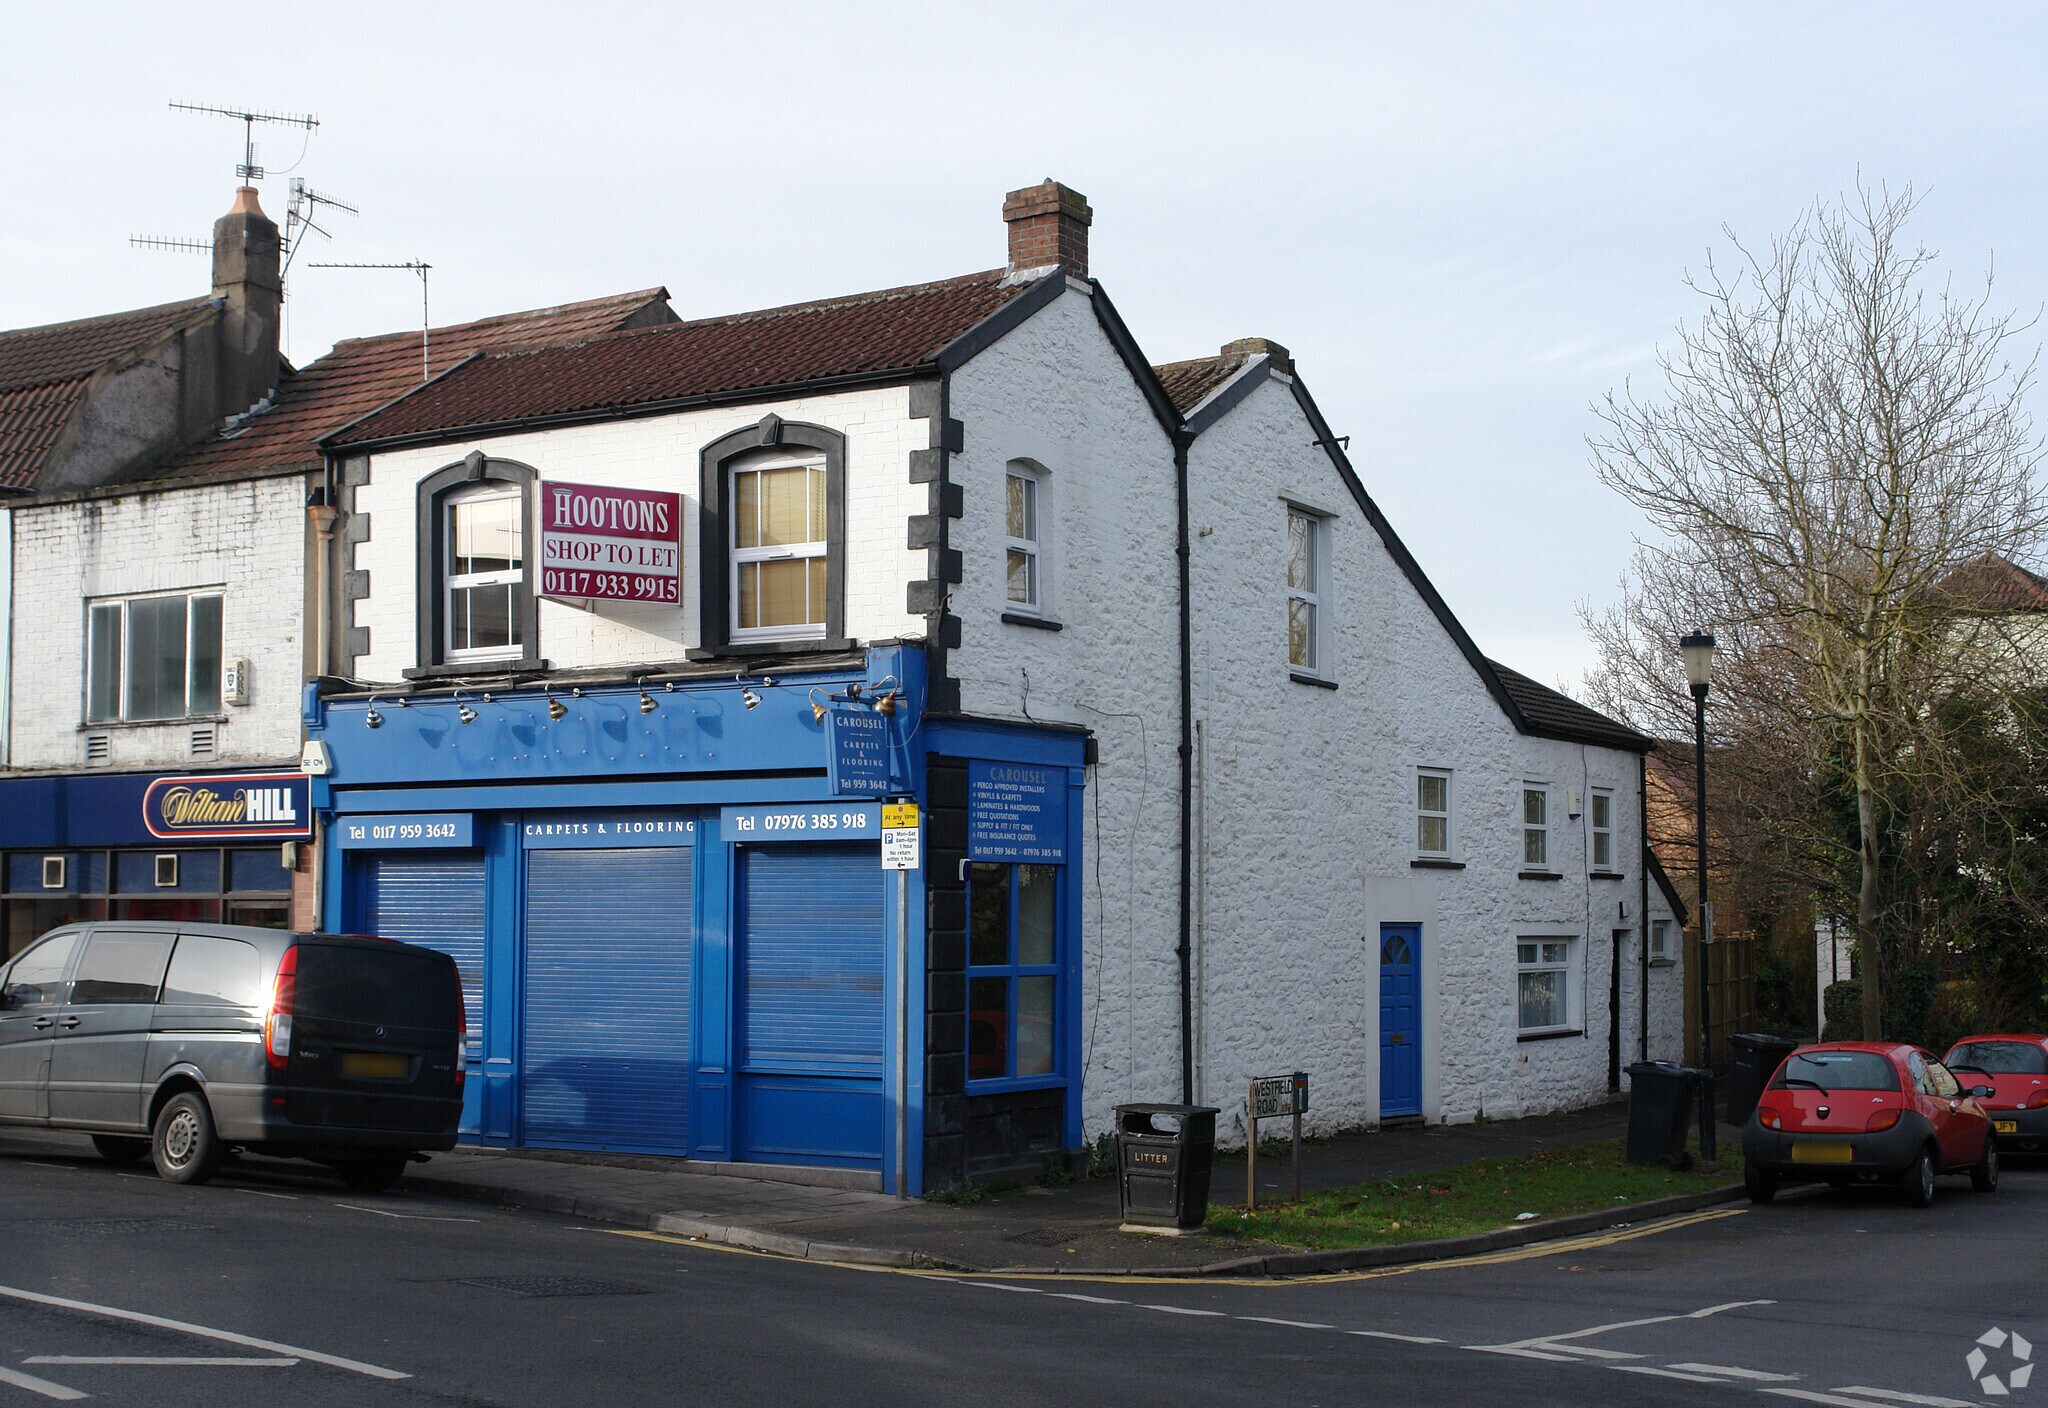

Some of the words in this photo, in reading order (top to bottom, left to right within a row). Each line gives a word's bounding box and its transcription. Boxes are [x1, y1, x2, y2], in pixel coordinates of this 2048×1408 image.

[552, 489, 669, 534] HOOTONS
[546, 539, 602, 562] SHOP
[605, 543, 633, 565] TO
[638, 546, 676, 568] LET
[545, 570, 591, 594] 0117
[596, 573, 629, 597] 933
[634, 576, 677, 600] 9915
[836, 717, 883, 729] CAROUSEL
[843, 741, 879, 750] CARPETS
[842, 758, 883, 767] FLOORING
[990, 767, 1046, 784] CAROUSEL
[840, 779, 852, 789] Tel
[853, 779, 867, 789] 959
[869, 780, 887, 790] 3642
[977, 782, 993, 790] PERGO
[994, 783, 1018, 791] APPROVED
[1019, 785, 1046, 794] INSTALLERS
[977, 792, 995, 800] VINYLS
[1001, 794, 1022, 802] CARPETS
[161, 786, 248, 824] William
[246, 788, 296, 822] HILL
[977, 802, 1004, 811] LAMINATES
[1010, 805, 1041, 813] HARDWOODS
[736, 816, 755, 831] Tel
[764, 815, 807, 830] 07976
[811, 814, 838, 830] 385
[842, 813, 867, 829] 918
[977, 812, 989, 820] FREE
[989, 812, 1020, 821] QUOTATIONS
[349, 826, 366, 840] Tel
[372, 825, 397, 839] 0117
[400, 824, 423, 839] 959
[425, 823, 456, 838] 3642
[525, 823, 589, 836] CARPETS
[597, 823, 607, 834] &
[616, 821, 695, 834] FLOORING
[977, 822, 994, 830] SUPPLY
[1021, 824, 1034, 832] ONLY
[977, 832, 989, 840] FREE
[990, 832, 1017, 841] INSURANCE
[1017, 834, 1037, 842] QUOTES
[974, 846, 982, 855] Tel
[983, 847, 993, 856] 0117
[994, 847, 1004, 856] 959
[1005, 848, 1018, 856] 3642
[1024, 848, 1040, 857] 07976
[1041, 849, 1052, 857] 385
[1253, 1080, 1294, 1098] WESTFIELD
[1256, 1099, 1278, 1115] ROAD
[1134, 1152, 1168, 1164] LITTER
